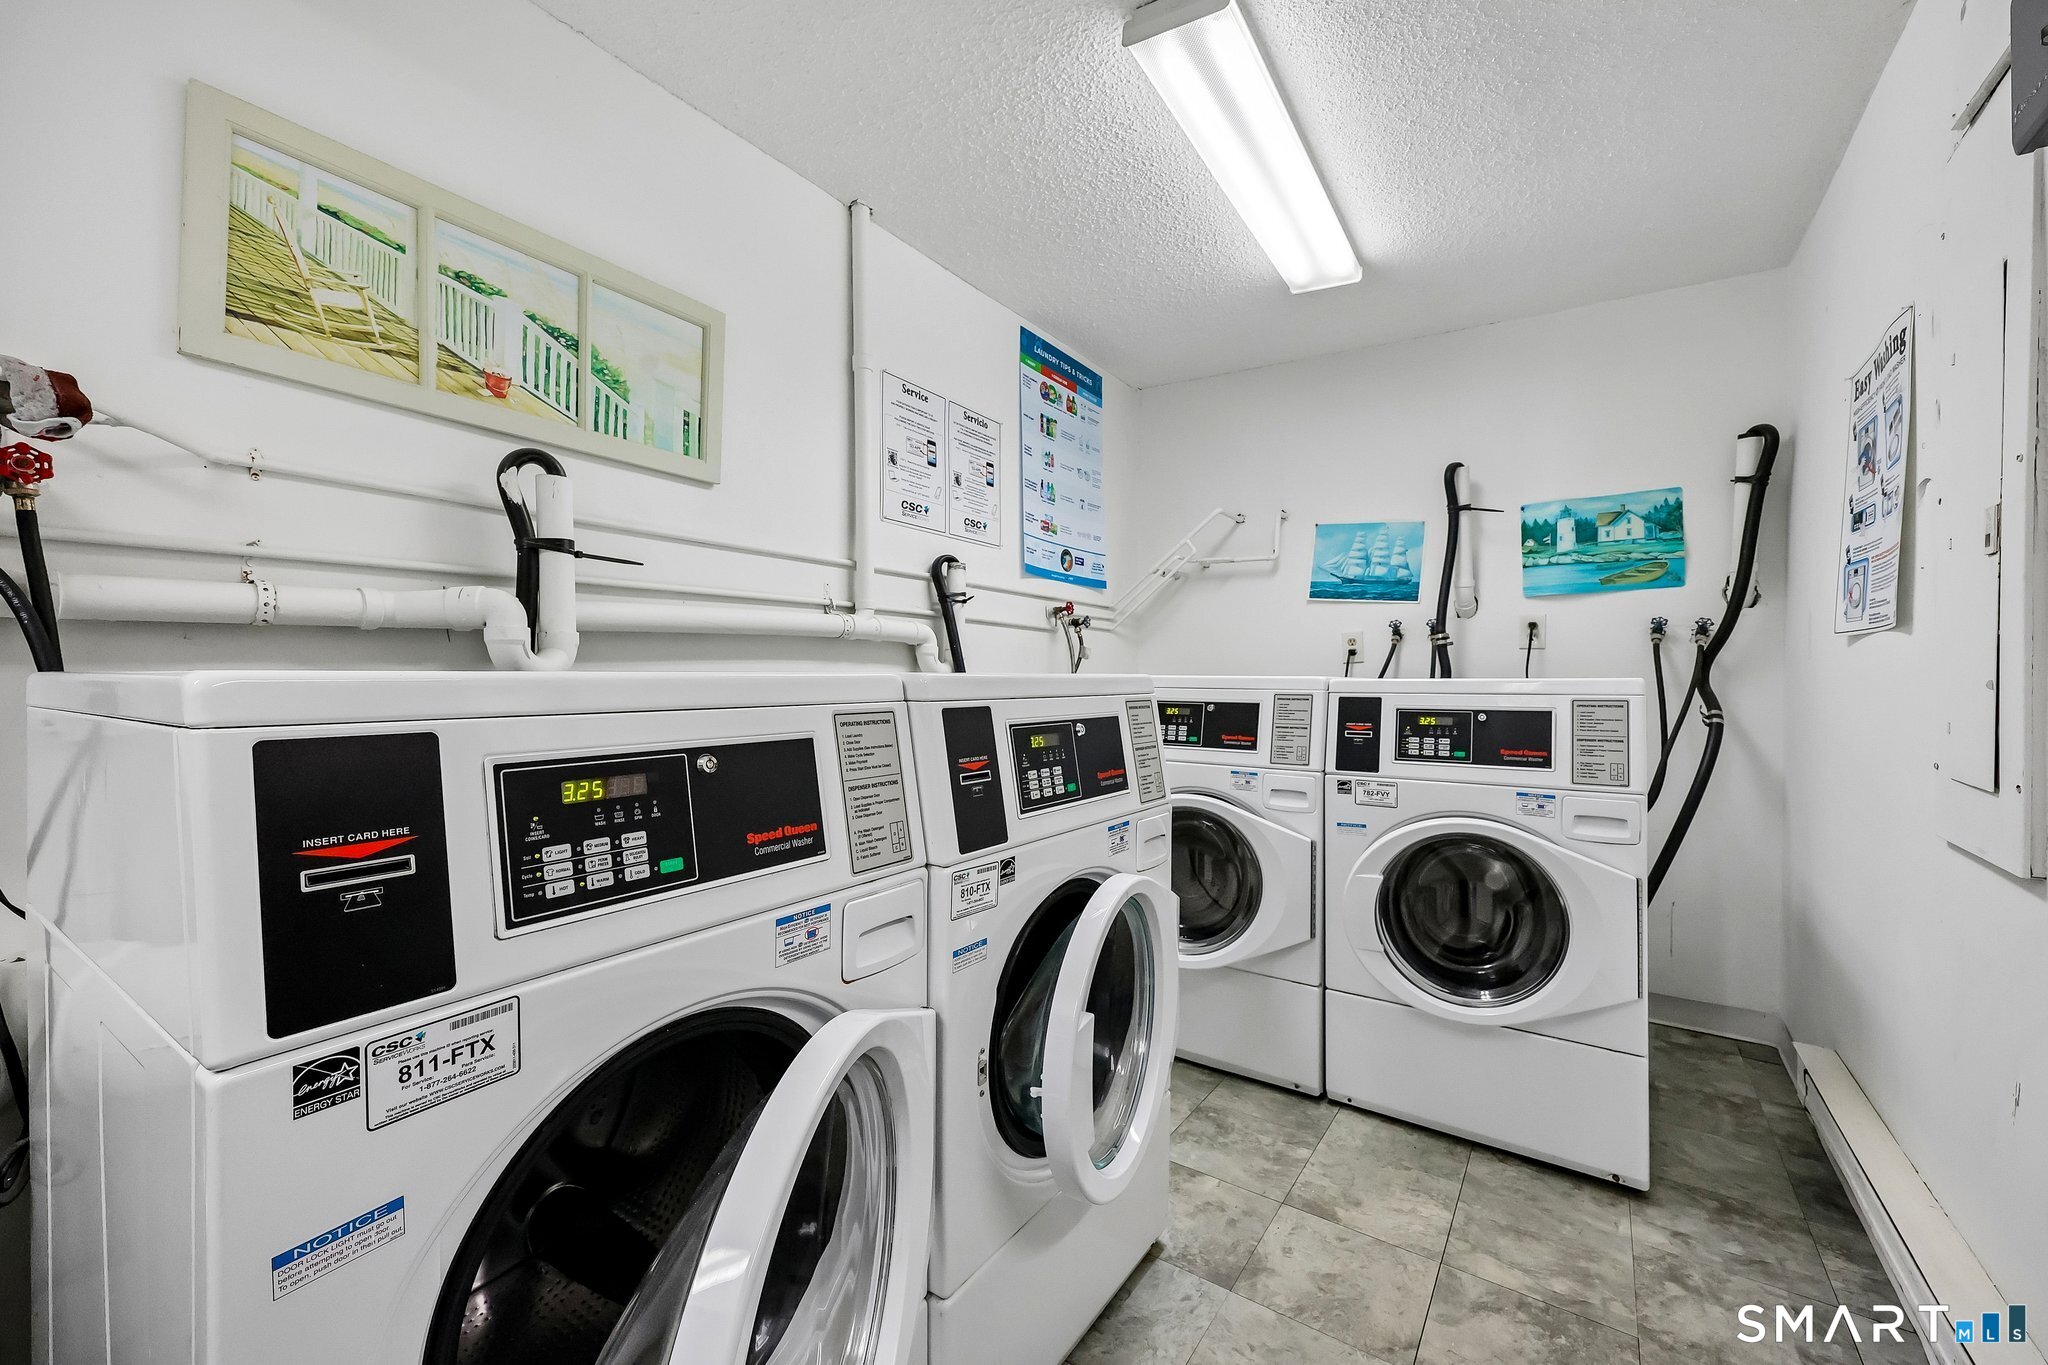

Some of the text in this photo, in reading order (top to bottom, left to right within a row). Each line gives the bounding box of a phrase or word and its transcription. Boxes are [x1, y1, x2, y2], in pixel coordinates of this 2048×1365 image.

[1034, 345, 1059, 365] LAUNDRY
[1060, 361, 1071, 373] TIPS
[1076, 371, 1092, 386] TRICKS
[1853, 370, 1872, 402] Easy
[1873, 326, 1907, 380] Washing
[901, 383, 928, 403] Service
[963, 410, 988, 429] Servicio
[901, 500, 923, 512] CSC
[964, 517, 982, 528] CSC
[563, 780, 602, 802] 3.25
[848, 779, 898, 792] DISPENSER INSTRUCTIONS
[1362, 789, 1390, 797] 782-FVY
[302, 826, 410, 848] INSERT CARD HERE
[746, 822, 817, 845] Speed Queen
[754, 836, 813, 856] Commercial Washer
[960, 881, 990, 898] 810-FTX
[793, 908, 815, 920] NOTICE
[957, 941, 983, 955] NOTICE
[371, 1036, 412, 1057] CSC
[397, 1056, 412, 1064] Please
[429, 1045, 446, 1054] machine
[462, 1034, 479, 1043] reporting
[398, 1034, 495, 1083] 811-FTX
[474, 1052, 496, 1063] Servicio:
[412, 1075, 434, 1086] Service:
[419, 1065, 476, 1091] 1-877-264-6622
[294, 1088, 359, 1118] ENERGY STAR
[385, 1105, 397, 1113] Visit
[409, 1094, 428, 1104] website
[293, 1205, 388, 1259] NOTICE
[277, 1214, 397, 1278] DOOR LOCK LIGHT must go out
[277, 1225, 391, 1285] before attempting to open door.
[278, 1284, 288, 1292] To
[289, 1273, 312, 1287] open,
[313, 1262, 332, 1276] push
[333, 1252, 350, 1264] door
[360, 1240, 376, 1251] then
[377, 1232, 390, 1244] pull
[390, 1226, 403, 1235] out.
